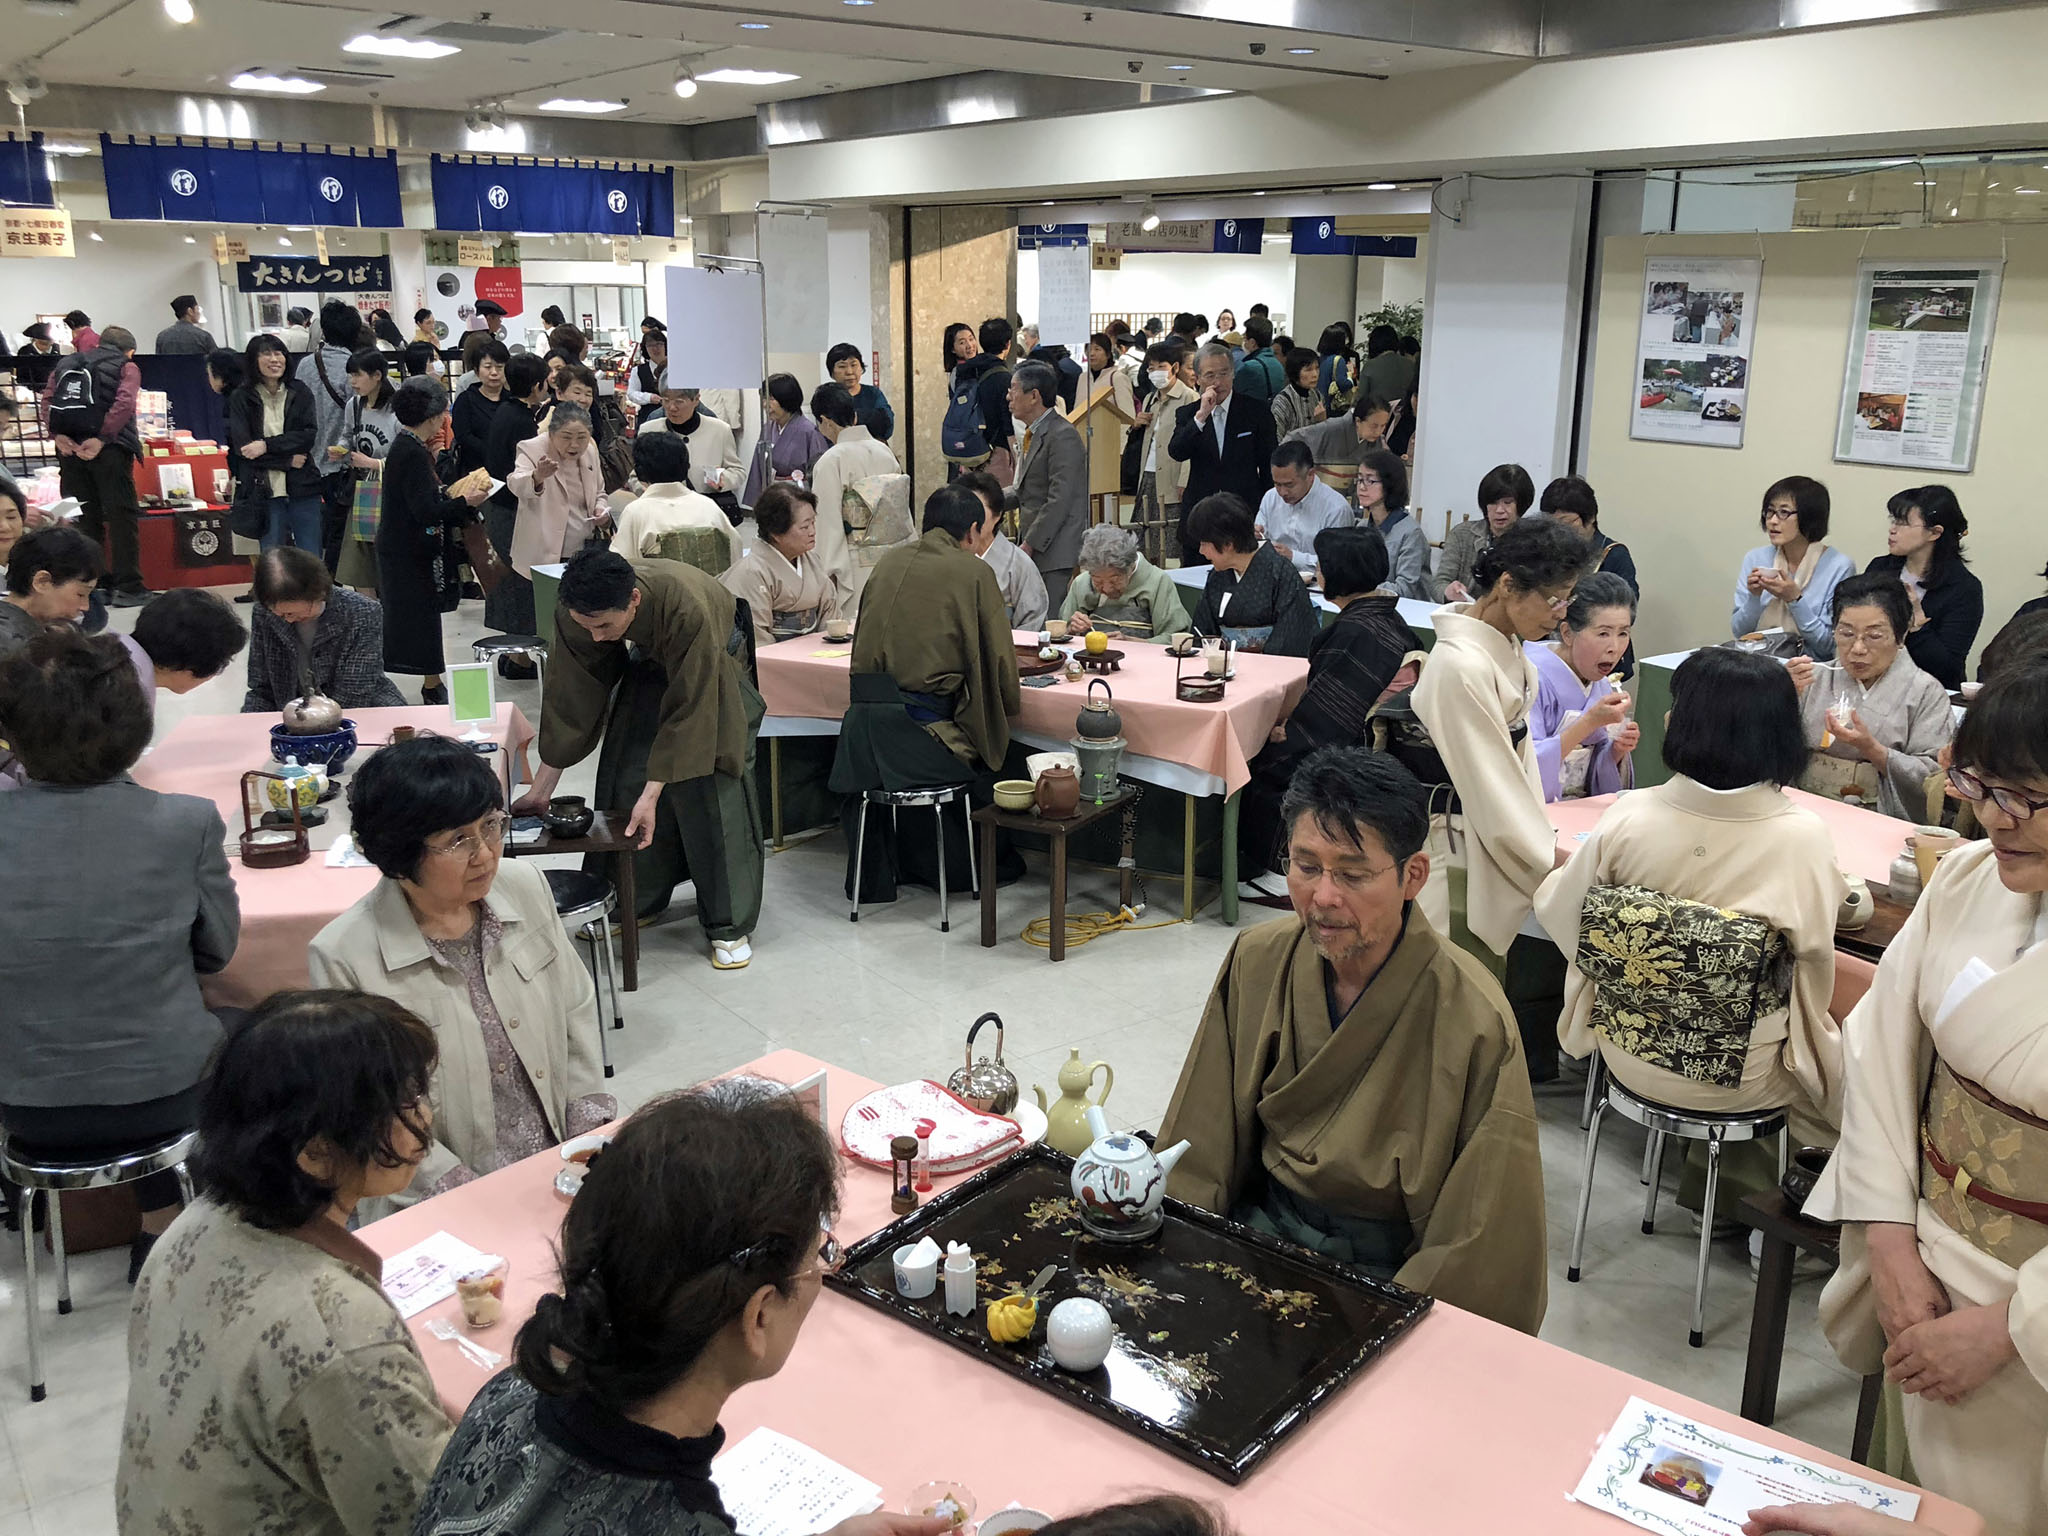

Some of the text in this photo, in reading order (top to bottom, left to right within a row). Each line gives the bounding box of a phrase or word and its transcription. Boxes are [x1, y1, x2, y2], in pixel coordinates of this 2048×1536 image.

[6, 231, 67, 246] 京生菓子
[460, 252, 492, 261] ロースハム
[252, 262, 371, 286] 大きんつば
